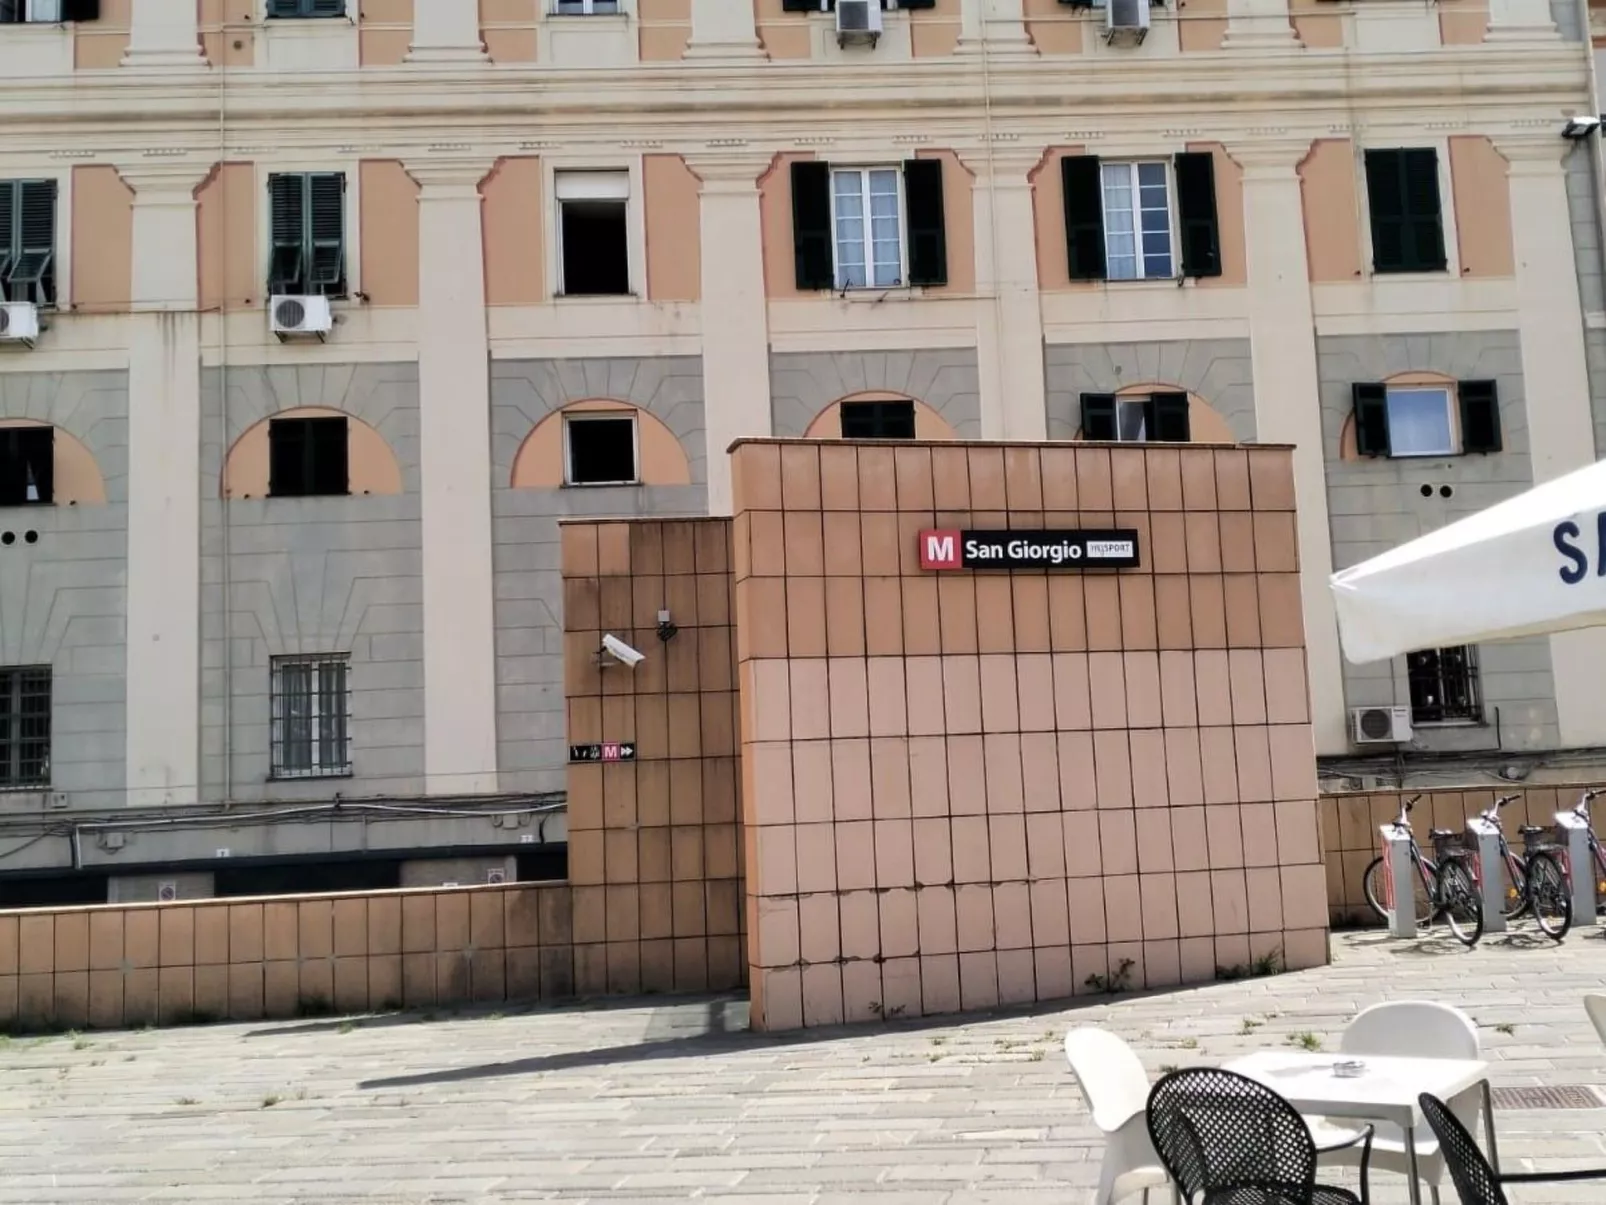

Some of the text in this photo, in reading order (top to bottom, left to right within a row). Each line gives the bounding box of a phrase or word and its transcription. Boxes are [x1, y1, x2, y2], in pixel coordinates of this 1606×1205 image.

[927, 536, 954, 562] M
[966, 540, 1003, 559] San
[1008, 540, 1082, 563] Giorgio
[604, 746, 618, 758] M
